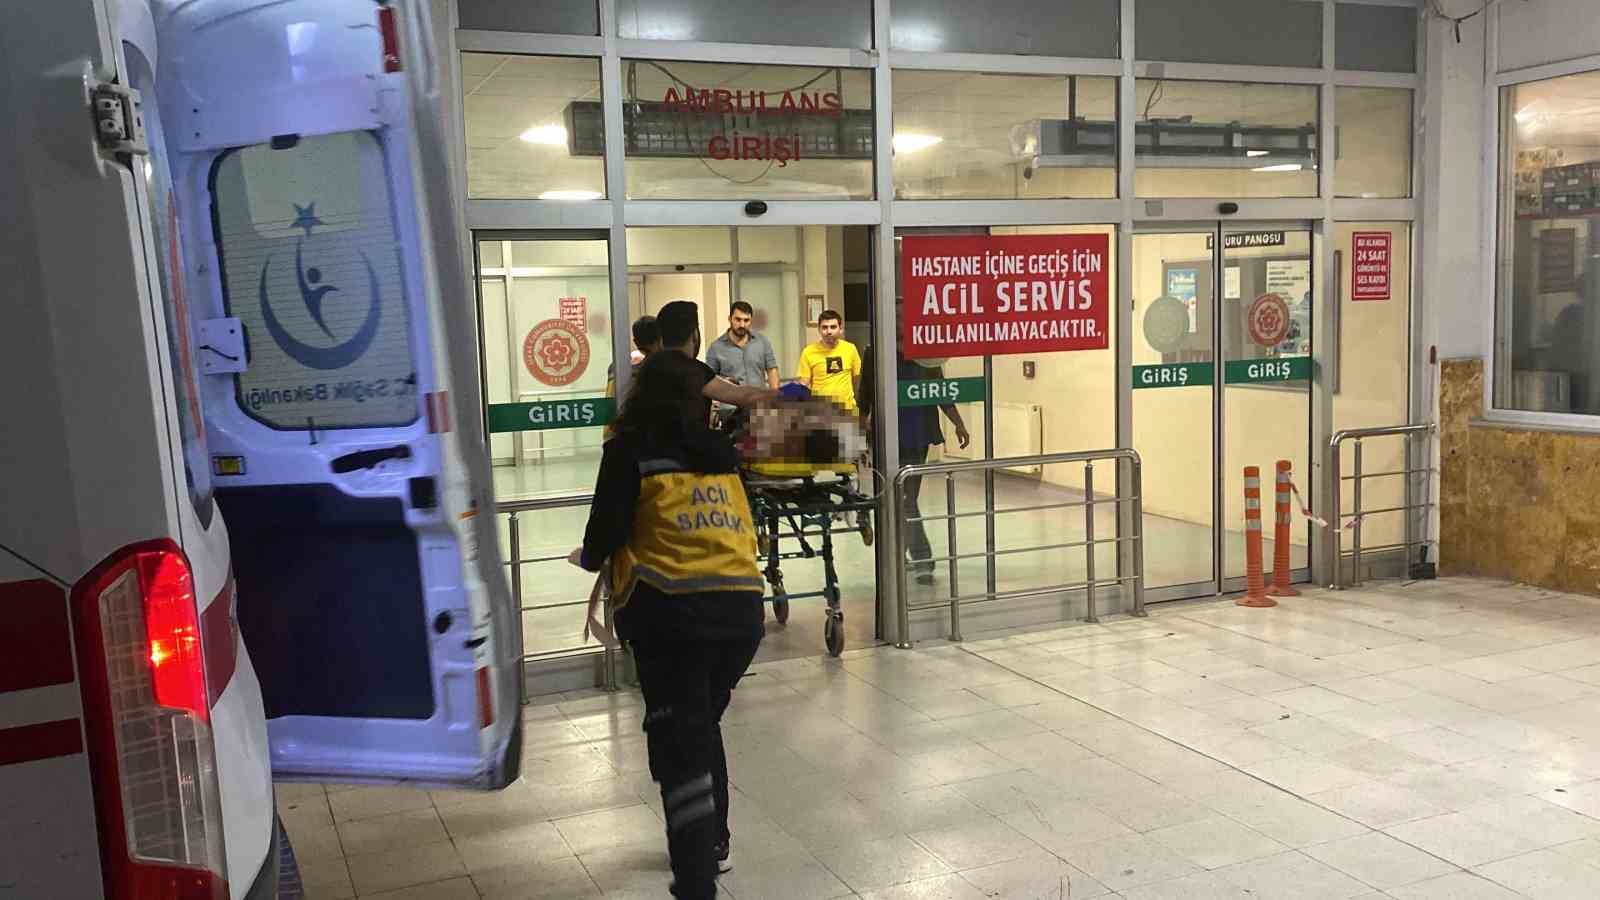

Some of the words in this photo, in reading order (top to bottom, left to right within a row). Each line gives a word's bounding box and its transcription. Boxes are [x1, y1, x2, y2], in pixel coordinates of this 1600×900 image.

[661, 87, 841, 117] AMBULANS
[912, 255, 981, 277] HASTANE
[985, 250, 1025, 279] İÇİNE
[1028, 249, 1069, 278] GEÇİŞ
[1072, 248, 1101, 277] İÇİN
[1357, 249, 1367, 262] 24
[922, 282, 984, 315] ACİL
[997, 279, 1092, 313] SERVİS
[912, 318, 1102, 345] KULLANILMAYACAKTIR.
[1141, 367, 1188, 385] GİRİŞ
[1248, 361, 1291, 379] GİRİŞ
[907, 381, 960, 401] GİRİŞ
[528, 402, 595, 424] GİRİŞ
